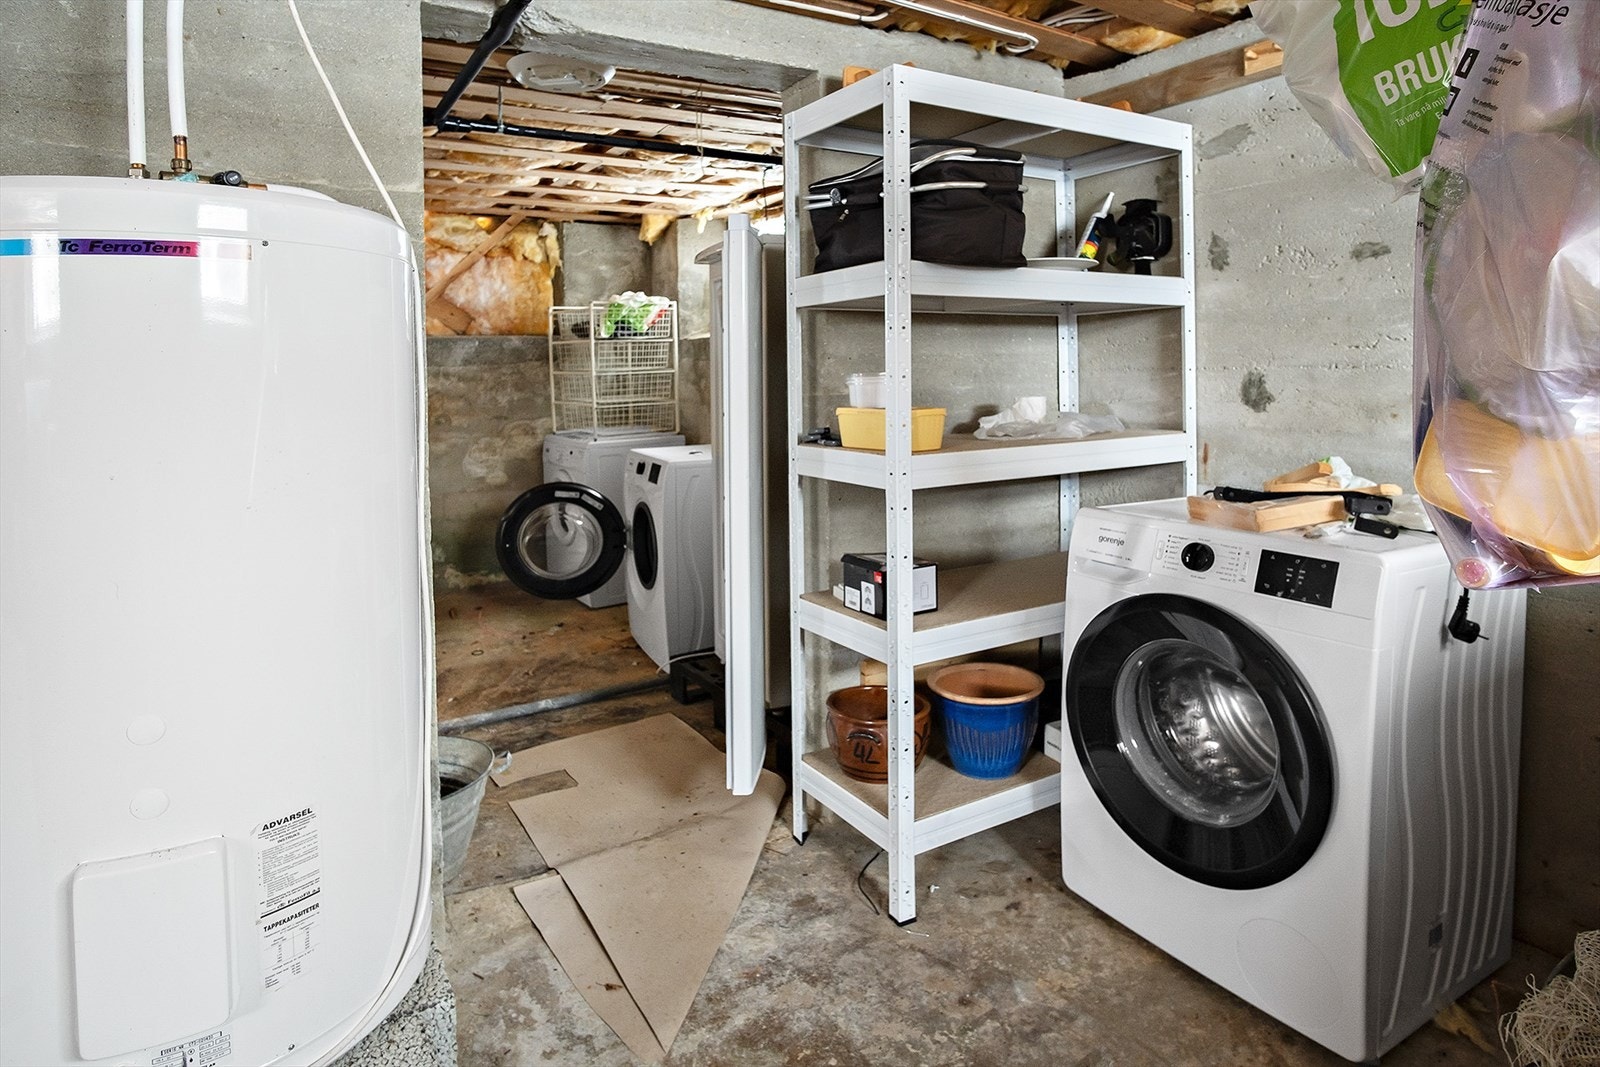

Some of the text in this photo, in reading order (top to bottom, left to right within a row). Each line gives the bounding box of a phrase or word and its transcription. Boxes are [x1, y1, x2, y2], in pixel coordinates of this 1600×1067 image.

[1374, 33, 1462, 107] BRUK
[1394, 118, 1405, 127] Ta
[1405, 110, 1421, 122] vare
[1421, 102, 1432, 114] på
[88, 240, 192, 254] FerroTerm
[1098, 535, 1125, 547] gorenje
[262, 808, 313, 831] ADVARSEL
[263, 903, 319, 932] TAPPEKAPASITETER
